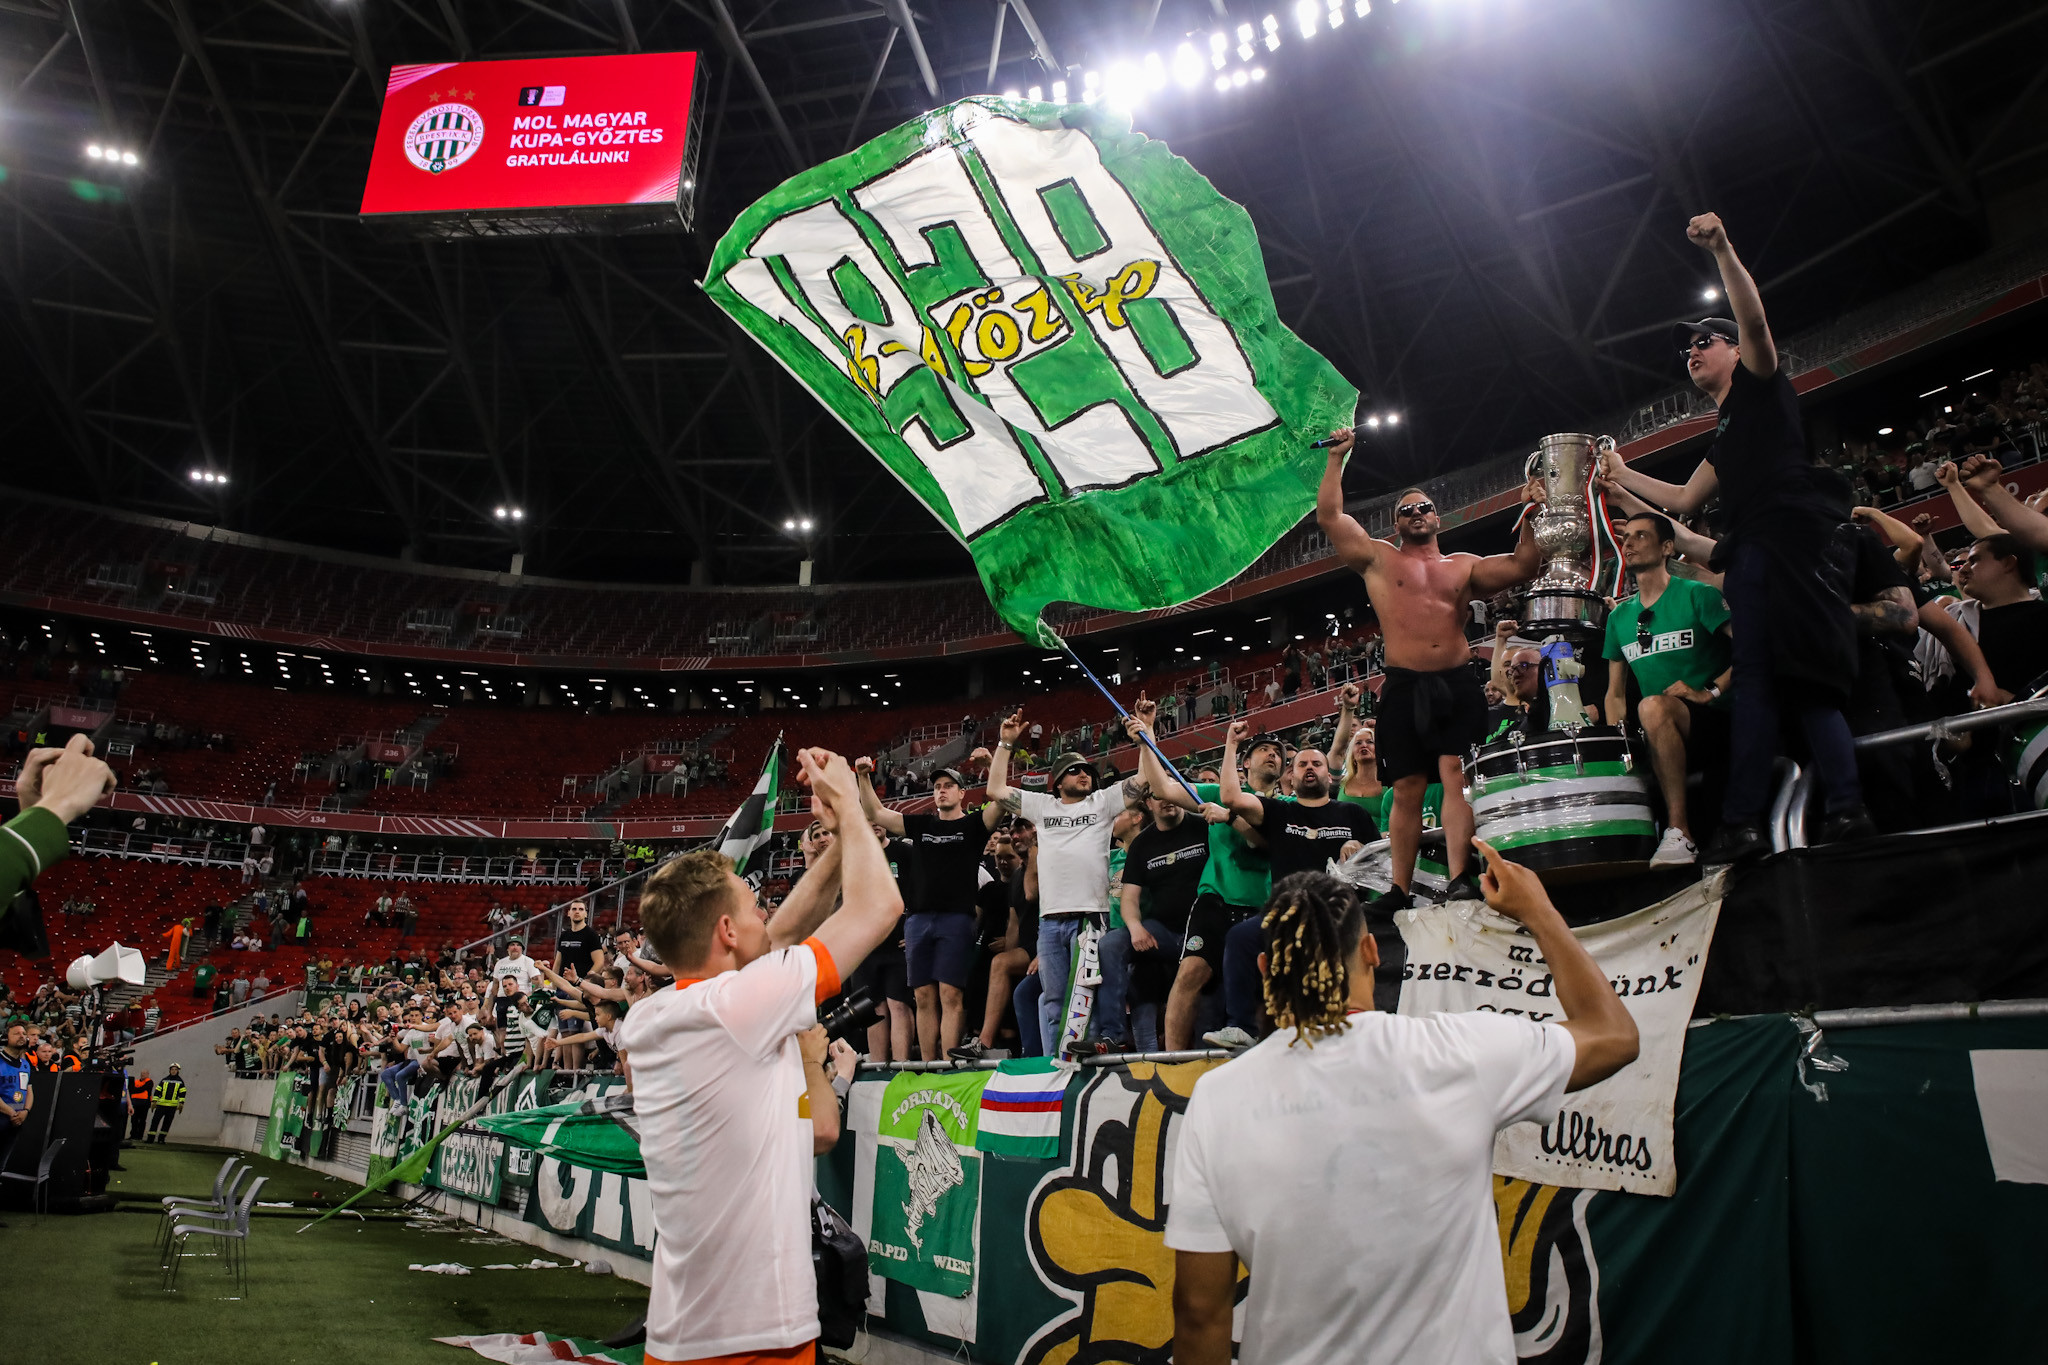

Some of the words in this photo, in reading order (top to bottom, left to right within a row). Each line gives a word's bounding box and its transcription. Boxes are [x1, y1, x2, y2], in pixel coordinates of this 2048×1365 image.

[513, 115, 557, 131] MOL
[563, 111, 647, 129] MAGYAR
[510, 126, 663, 148] KUPA-GYŐZTES
[506, 150, 630, 167] GRATULÁLUNK!
[384, 749, 399, 757] 236
[310, 815, 326, 824] 134
[671, 825, 685, 833] 133
[892, 1089, 969, 1131] TORNADOS
[1541, 1110, 1652, 1171] Ultras
[933, 1254, 972, 1276] WIEN
